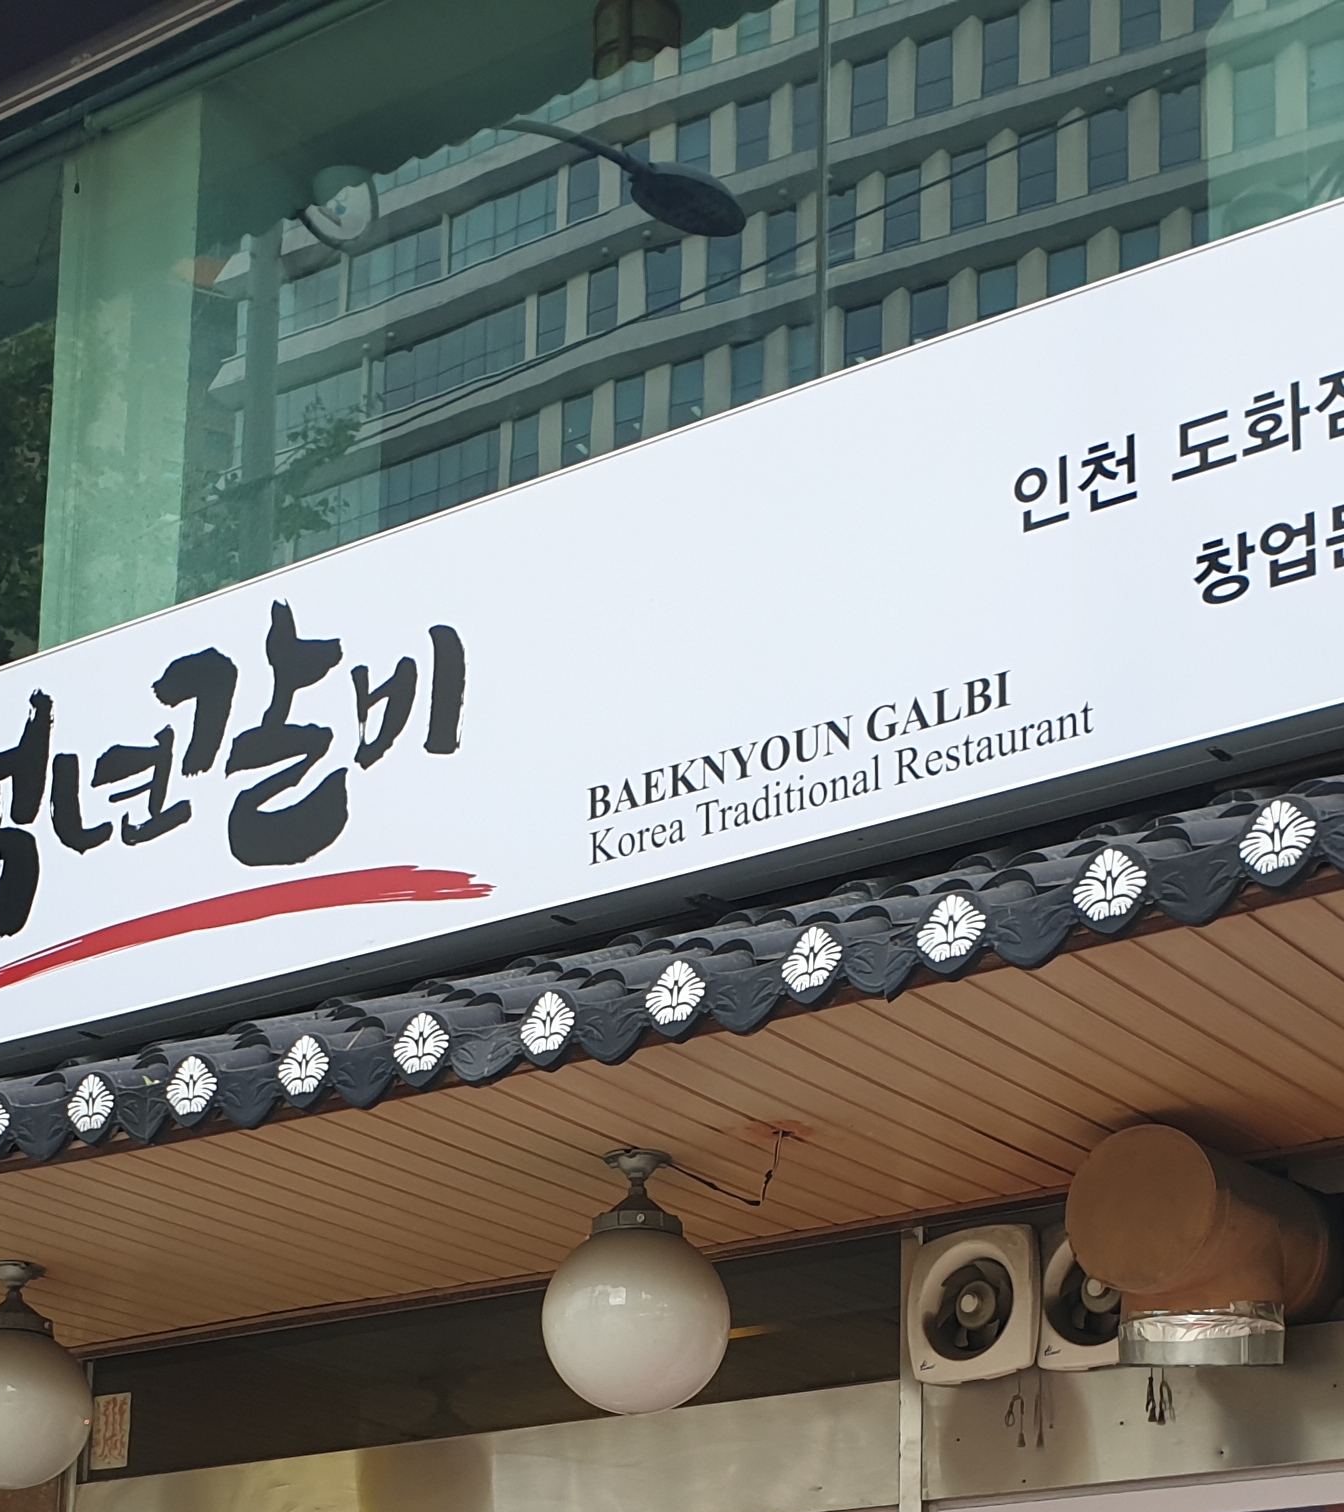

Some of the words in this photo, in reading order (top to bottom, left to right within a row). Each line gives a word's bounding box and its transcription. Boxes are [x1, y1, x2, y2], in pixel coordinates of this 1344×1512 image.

[1012, 434, 1140, 533] 인천
[586, 716, 853, 820] BAEKNYOUN
[866, 670, 1012, 742] GALBI
[588, 819, 686, 865] Korea
[696, 755, 881, 838] Traditional
[894, 701, 1095, 785] Restaurant
